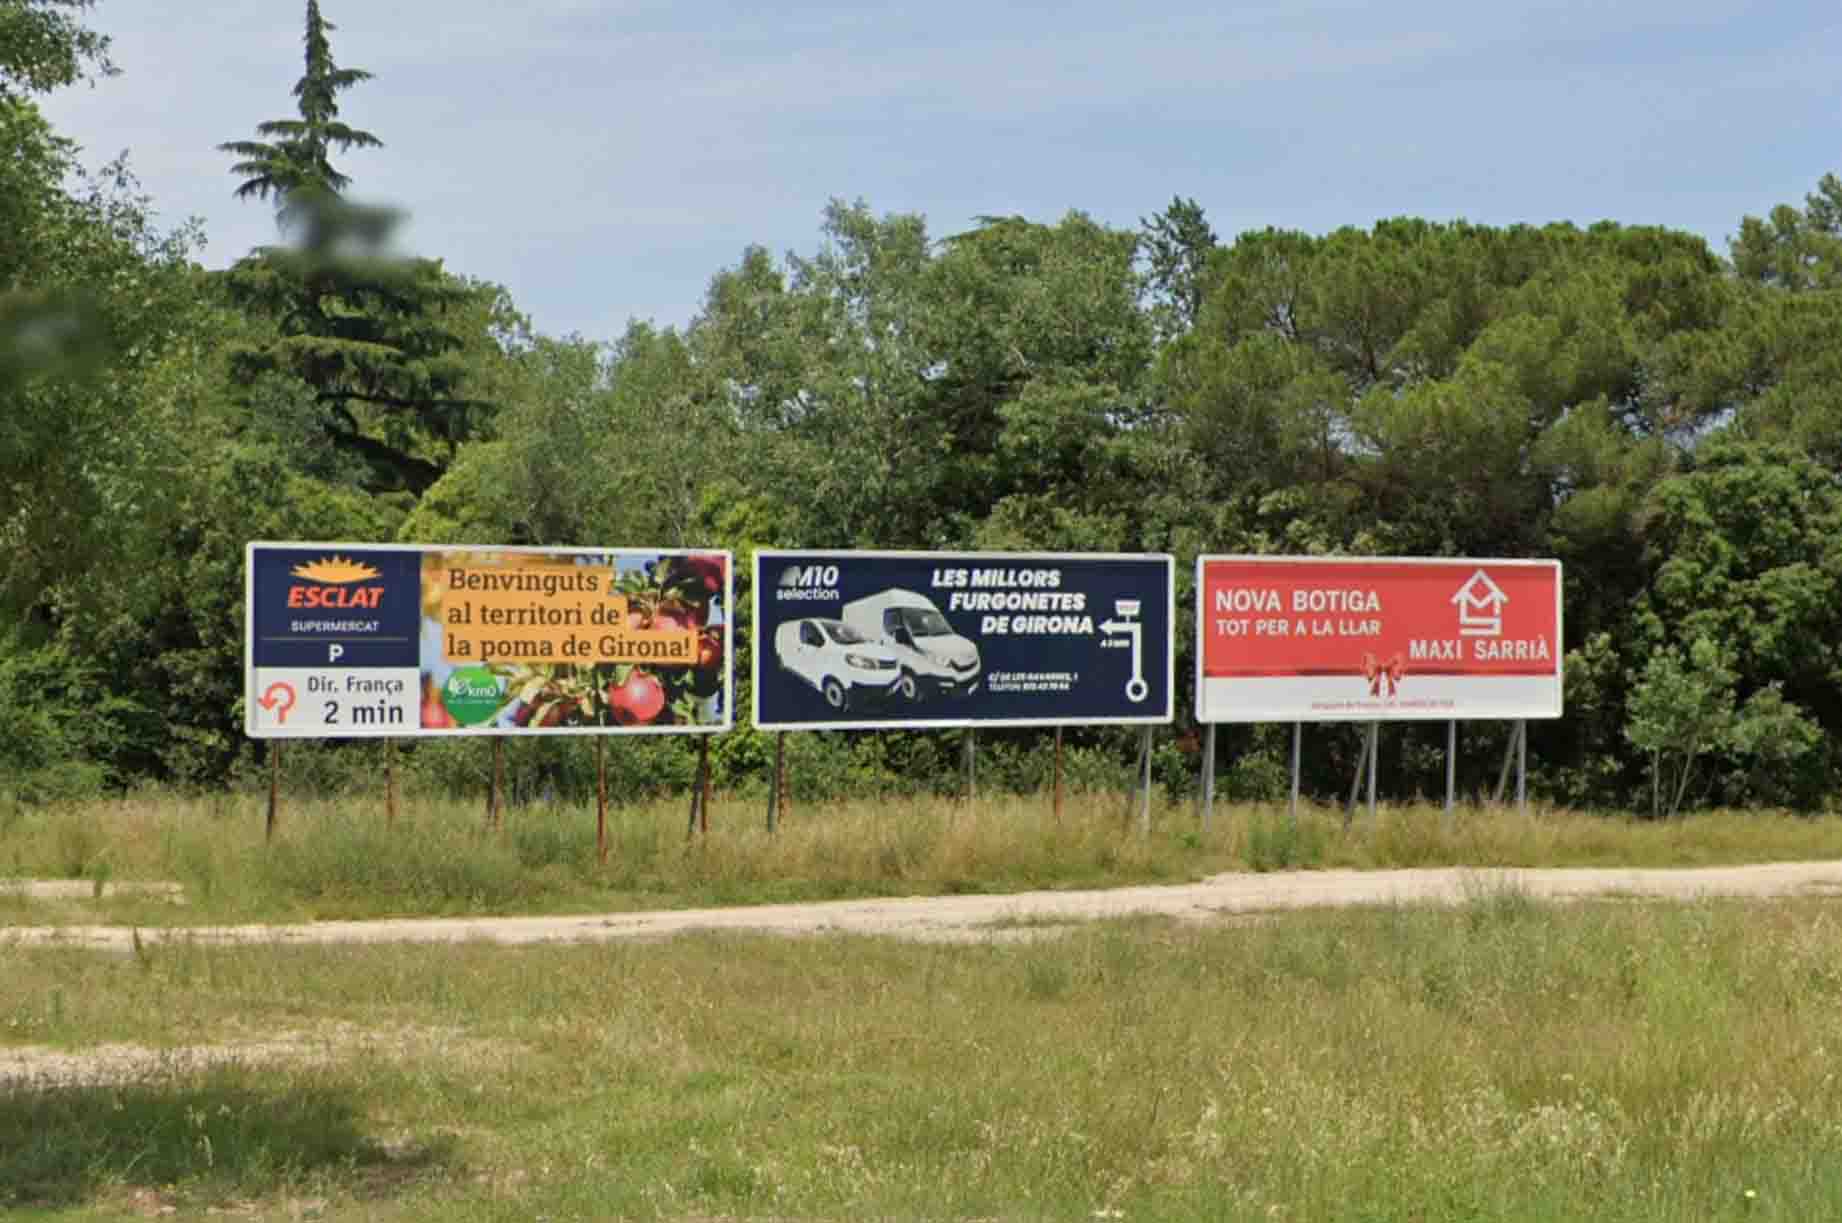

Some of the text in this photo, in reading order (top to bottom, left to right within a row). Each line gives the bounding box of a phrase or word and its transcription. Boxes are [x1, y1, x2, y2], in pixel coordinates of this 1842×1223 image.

[449, 568, 599, 596] Benvinguts
[780, 565, 839, 587] M10
[932, 569, 1061, 587] LES MILLORS
[287, 586, 384, 608] ESCLAT
[776, 588, 840, 600] selection
[950, 593, 1086, 611] FURGONETES
[1215, 590, 1381, 612] NOVA BOTIGA
[448, 602, 620, 625] al territori de
[290, 620, 379, 632] SUPERMERCAT
[981, 616, 1094, 634] DE GIRONA
[1215, 619, 1382, 636] TOT PER A LA LLAR
[328, 643, 344, 662] P
[448, 634, 690, 661] la poma de Girona!
[1409, 634, 1550, 660] MAXI SARRIÀ
[308, 676, 404, 695] Dir. França
[324, 699, 404, 724] 2 min
